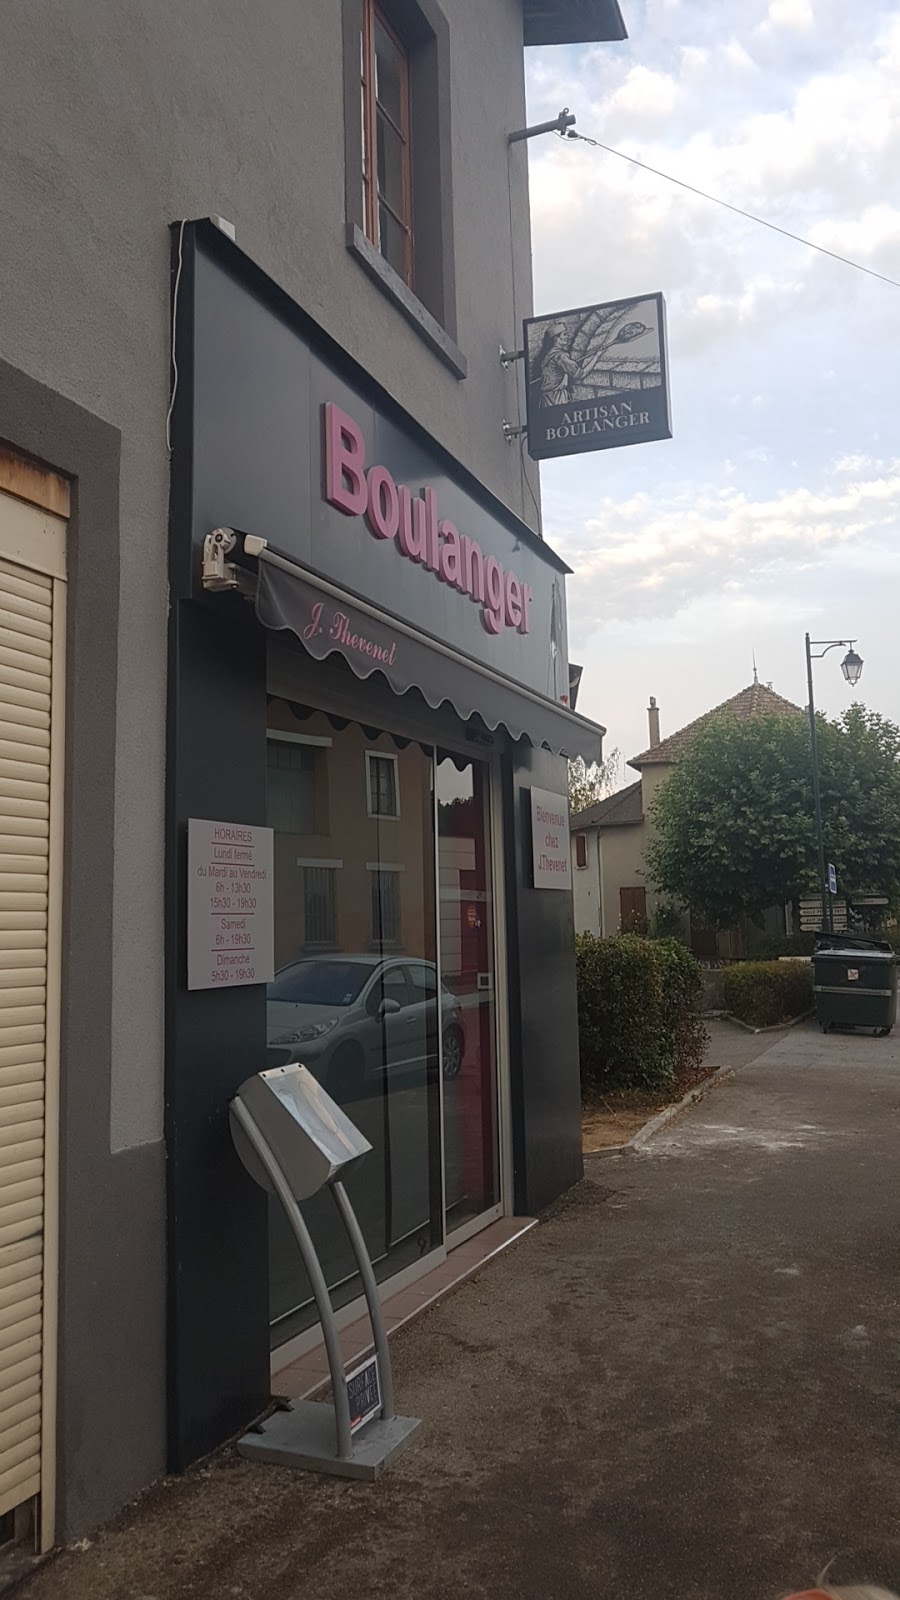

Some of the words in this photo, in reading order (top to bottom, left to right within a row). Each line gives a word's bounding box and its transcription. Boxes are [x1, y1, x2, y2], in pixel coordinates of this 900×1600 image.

[561, 401, 632, 425] ARTISAN
[546, 411, 650, 440] BOULANGER
[325, 401, 533, 634] Boulanger
[303, 602, 324, 640] J.
[536, 805, 565, 827] Bienvenue
[214, 827, 253, 842] HORAIRES
[545, 832, 559, 849] chez
[213, 847, 233, 861] Lundi
[197, 867, 207, 877] du
[208, 867, 228, 878] Mardi
[229, 869, 238, 878] au
[239, 868, 267, 880] Vendredi
[215, 881, 225, 893] 6h
[231, 882, 251, 894] 13h30
[210, 897, 230, 909] 15h30
[237, 898, 257, 909] 19h30
[220, 918, 246, 930] Samedi
[215, 934, 225, 946] 6h
[231, 933, 251, 945] 19h30
[216, 954, 250, 966] Dimanche
[211, 969, 229, 983] 5h30
[235, 967, 255, 980] 19h30
